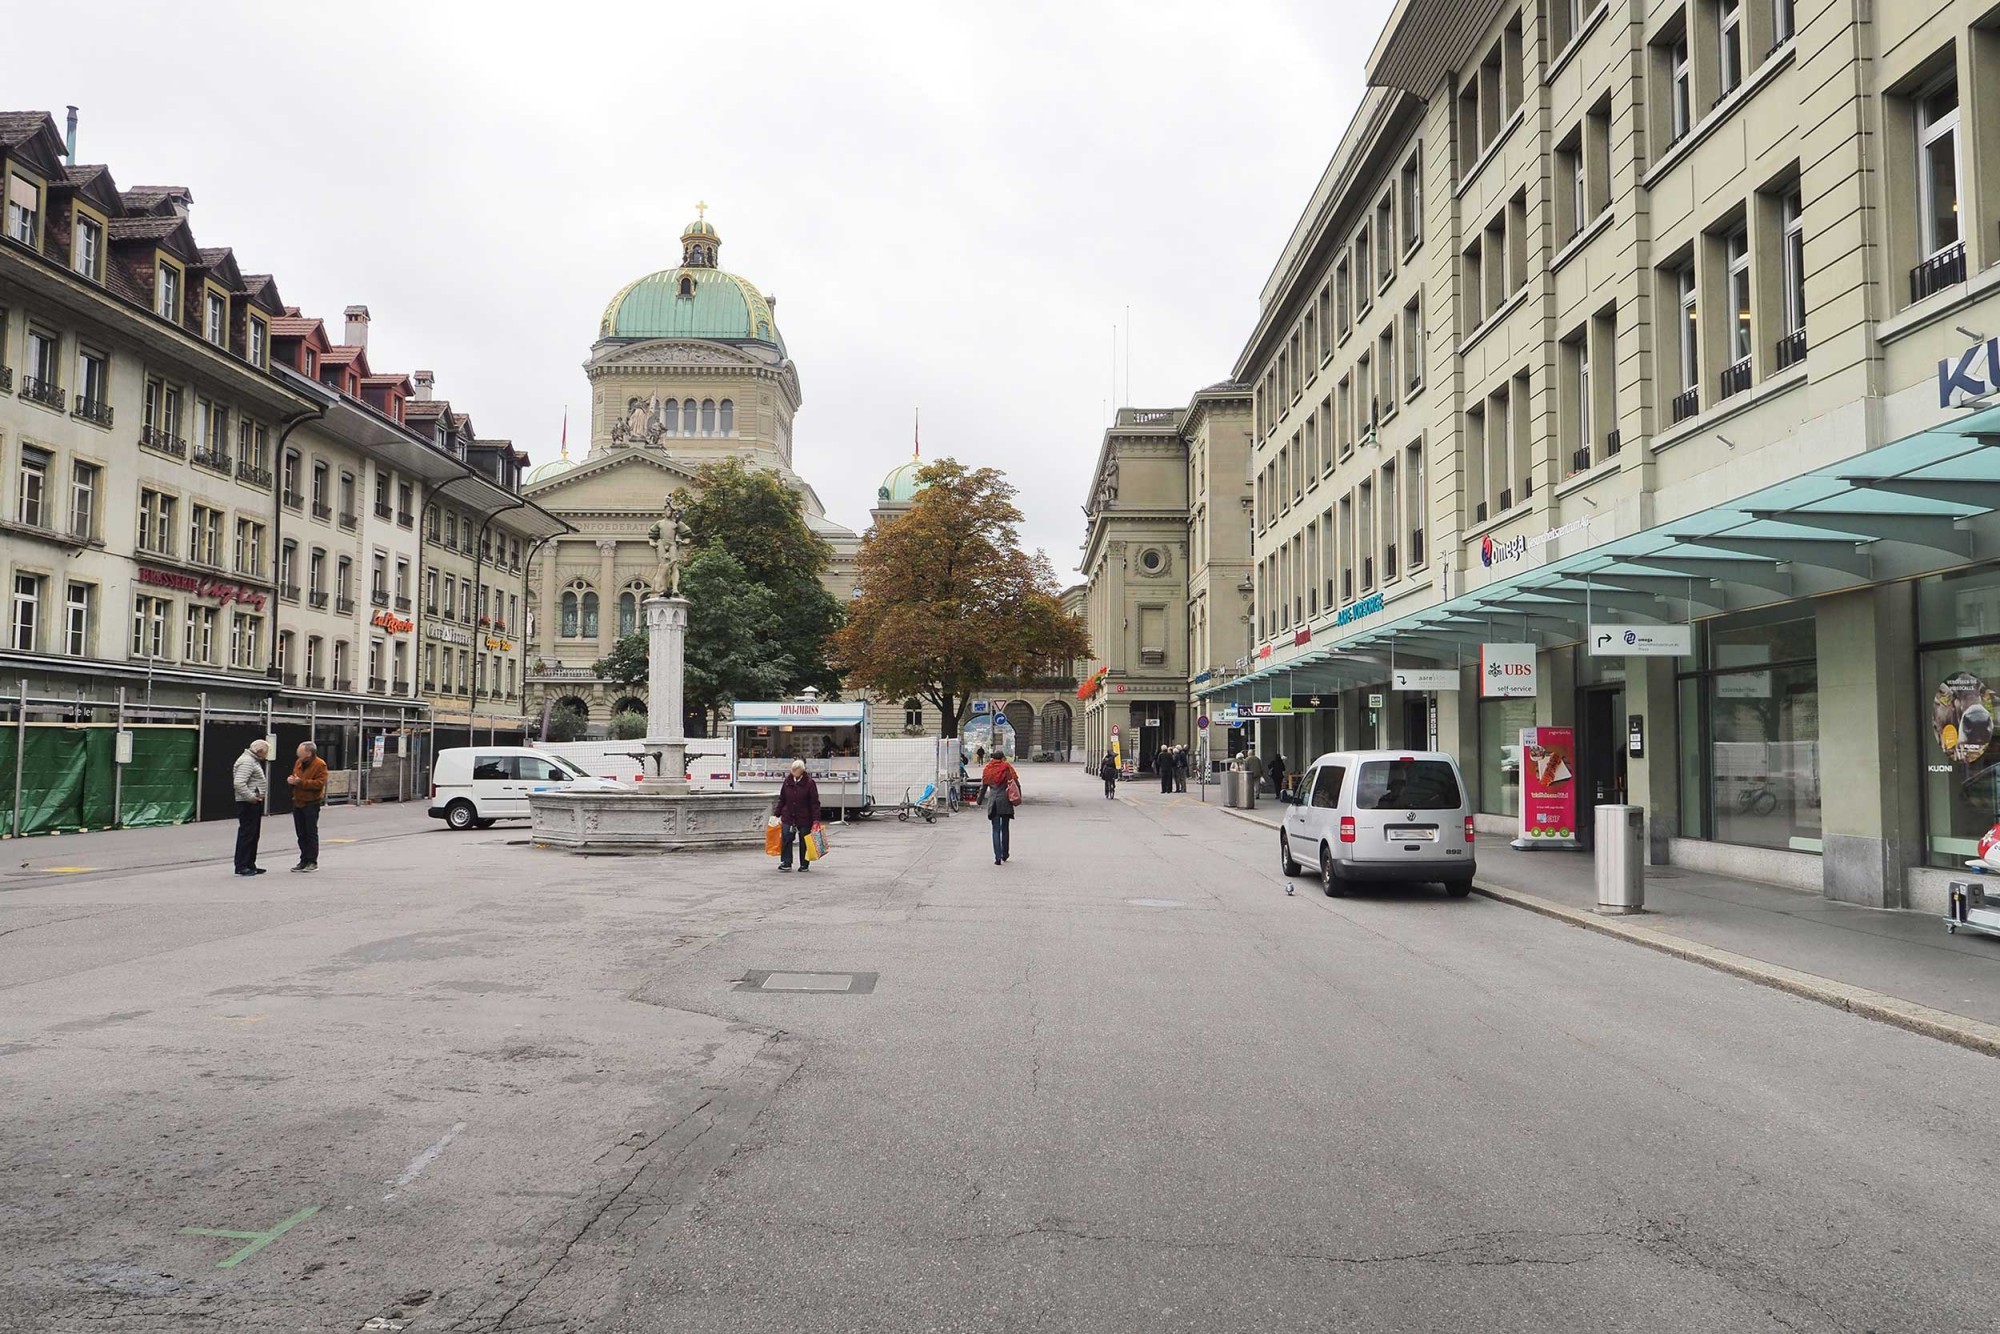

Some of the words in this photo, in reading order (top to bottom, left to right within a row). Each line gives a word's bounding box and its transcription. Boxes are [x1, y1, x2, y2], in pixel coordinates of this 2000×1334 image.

[1492, 534, 1526, 564] omega
[140, 567, 198, 591] BRASSERIE
[1505, 664, 1532, 676] UBS
[1497, 685, 1532, 693] self-service
[780, 704, 819, 715] MINI-IMBISS
